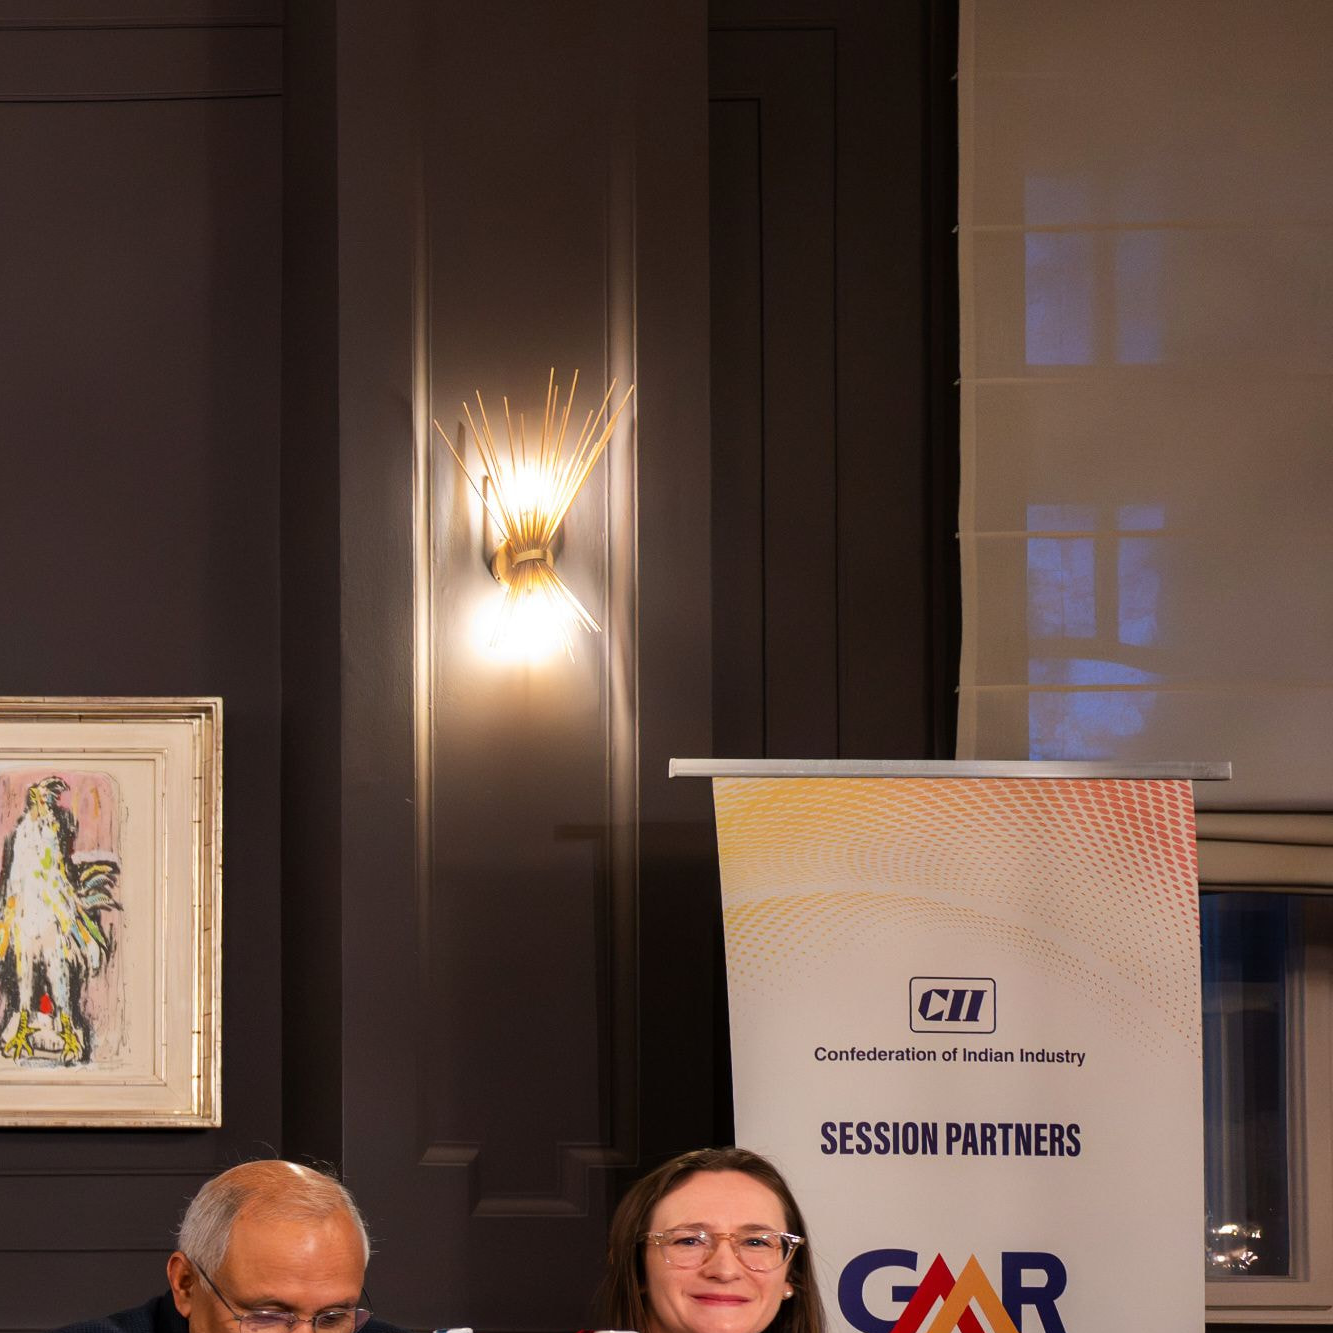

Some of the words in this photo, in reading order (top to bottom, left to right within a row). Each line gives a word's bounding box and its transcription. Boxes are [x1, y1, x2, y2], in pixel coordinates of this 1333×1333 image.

[918, 989, 986, 1022] CII
[814, 1046, 937, 1062] Confederation
[941, 1047, 958, 1062] of
[962, 1047, 1015, 1063] Indian
[1019, 1048, 1086, 1067] Industry
[820, 1121, 938, 1156] SESSION
[945, 1122, 1081, 1157] PARTNERS
